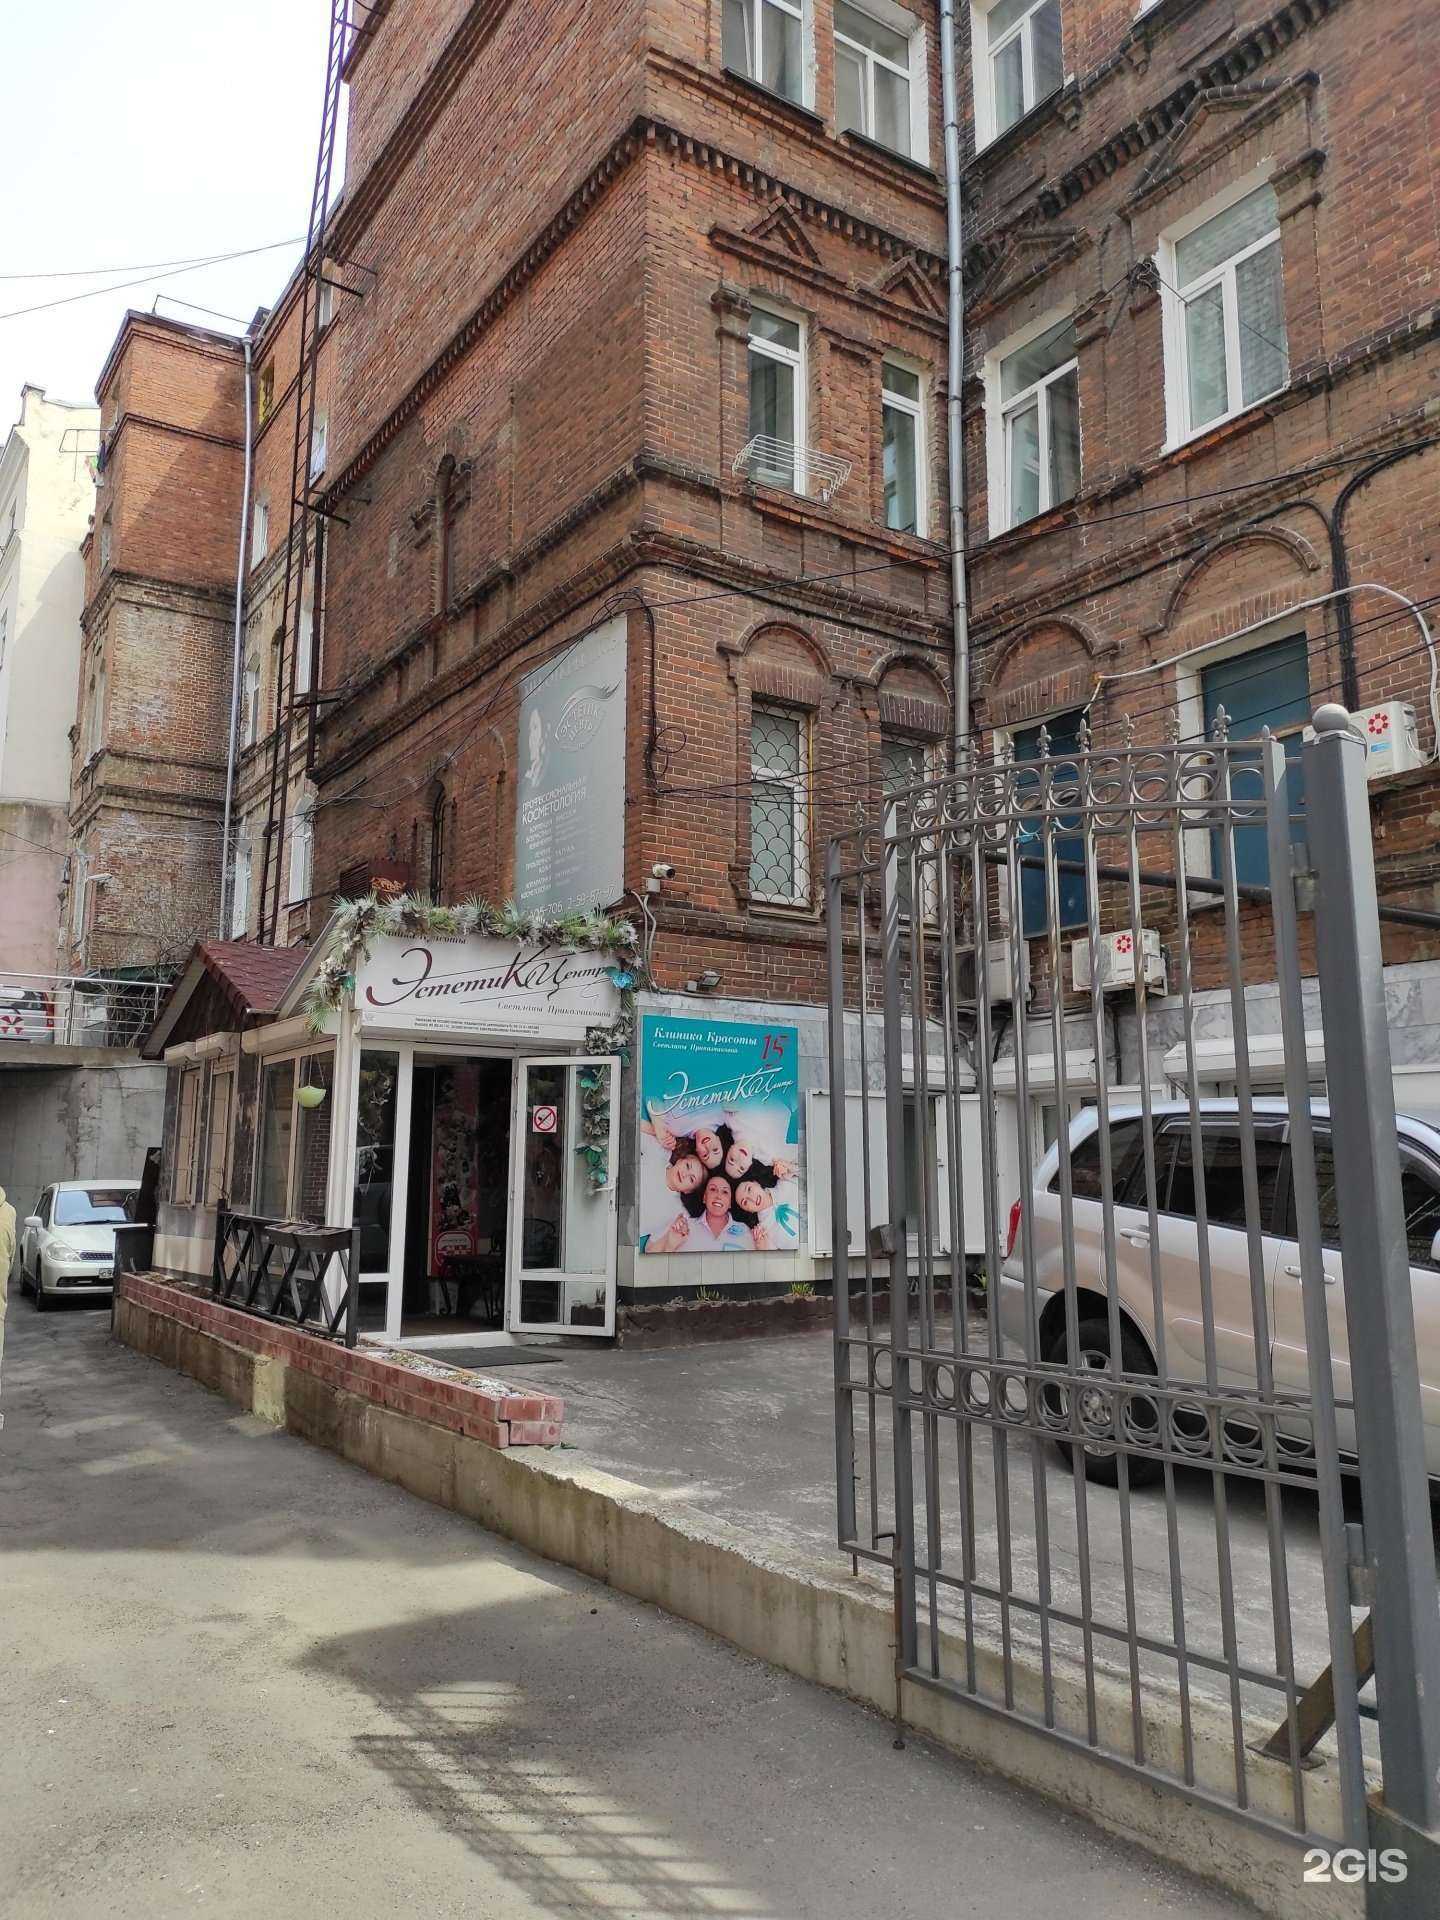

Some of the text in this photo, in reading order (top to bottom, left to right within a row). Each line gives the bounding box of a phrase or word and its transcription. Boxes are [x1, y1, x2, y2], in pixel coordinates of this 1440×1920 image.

[522, 787, 587, 824] КОСМЕТОЛОГИЯ
[497, 1001, 543, 1013] Светланы
[654, 1027, 759, 1046] Клиника Красоты
[653, 1041, 687, 1051] Светланы
